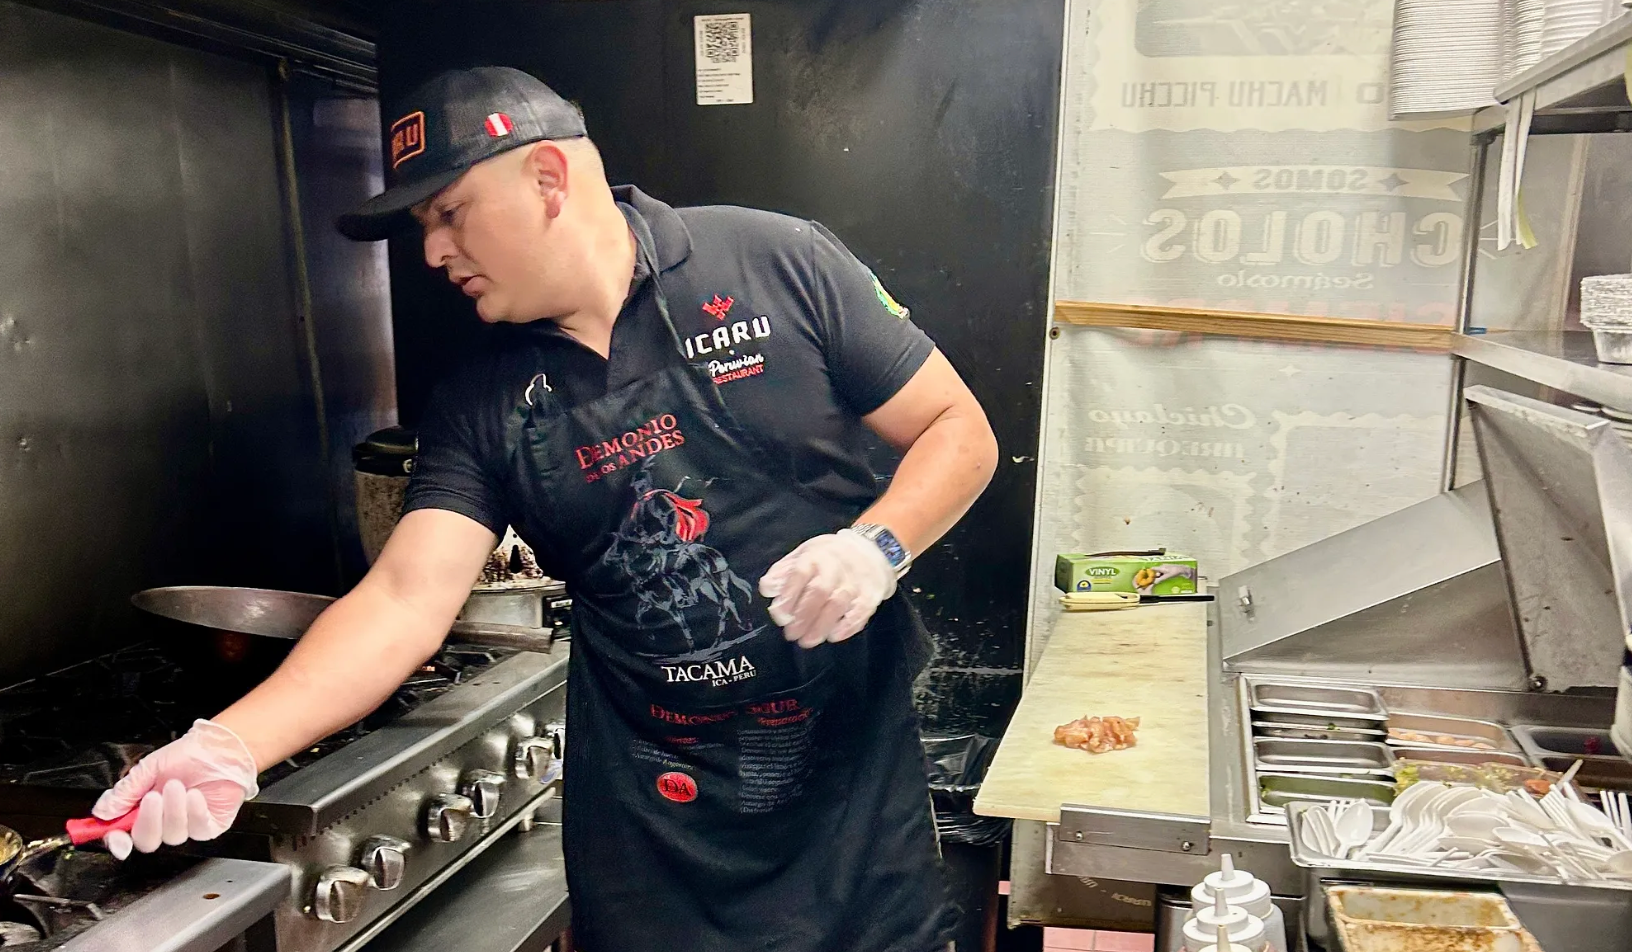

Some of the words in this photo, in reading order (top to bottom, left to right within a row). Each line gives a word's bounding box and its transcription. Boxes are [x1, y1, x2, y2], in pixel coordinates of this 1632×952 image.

[684, 316, 771, 359] ICARU
[708, 353, 764, 377] Peruvian
[575, 413, 678, 470] DEMONIO
[618, 430, 686, 470] ANDES
[1088, 568, 1117, 576] VINYL
[661, 655, 755, 683] TACAMA
[712, 678, 728, 687] ICA
[733, 669, 757, 682] PERU
[663, 778, 692, 797] DA
